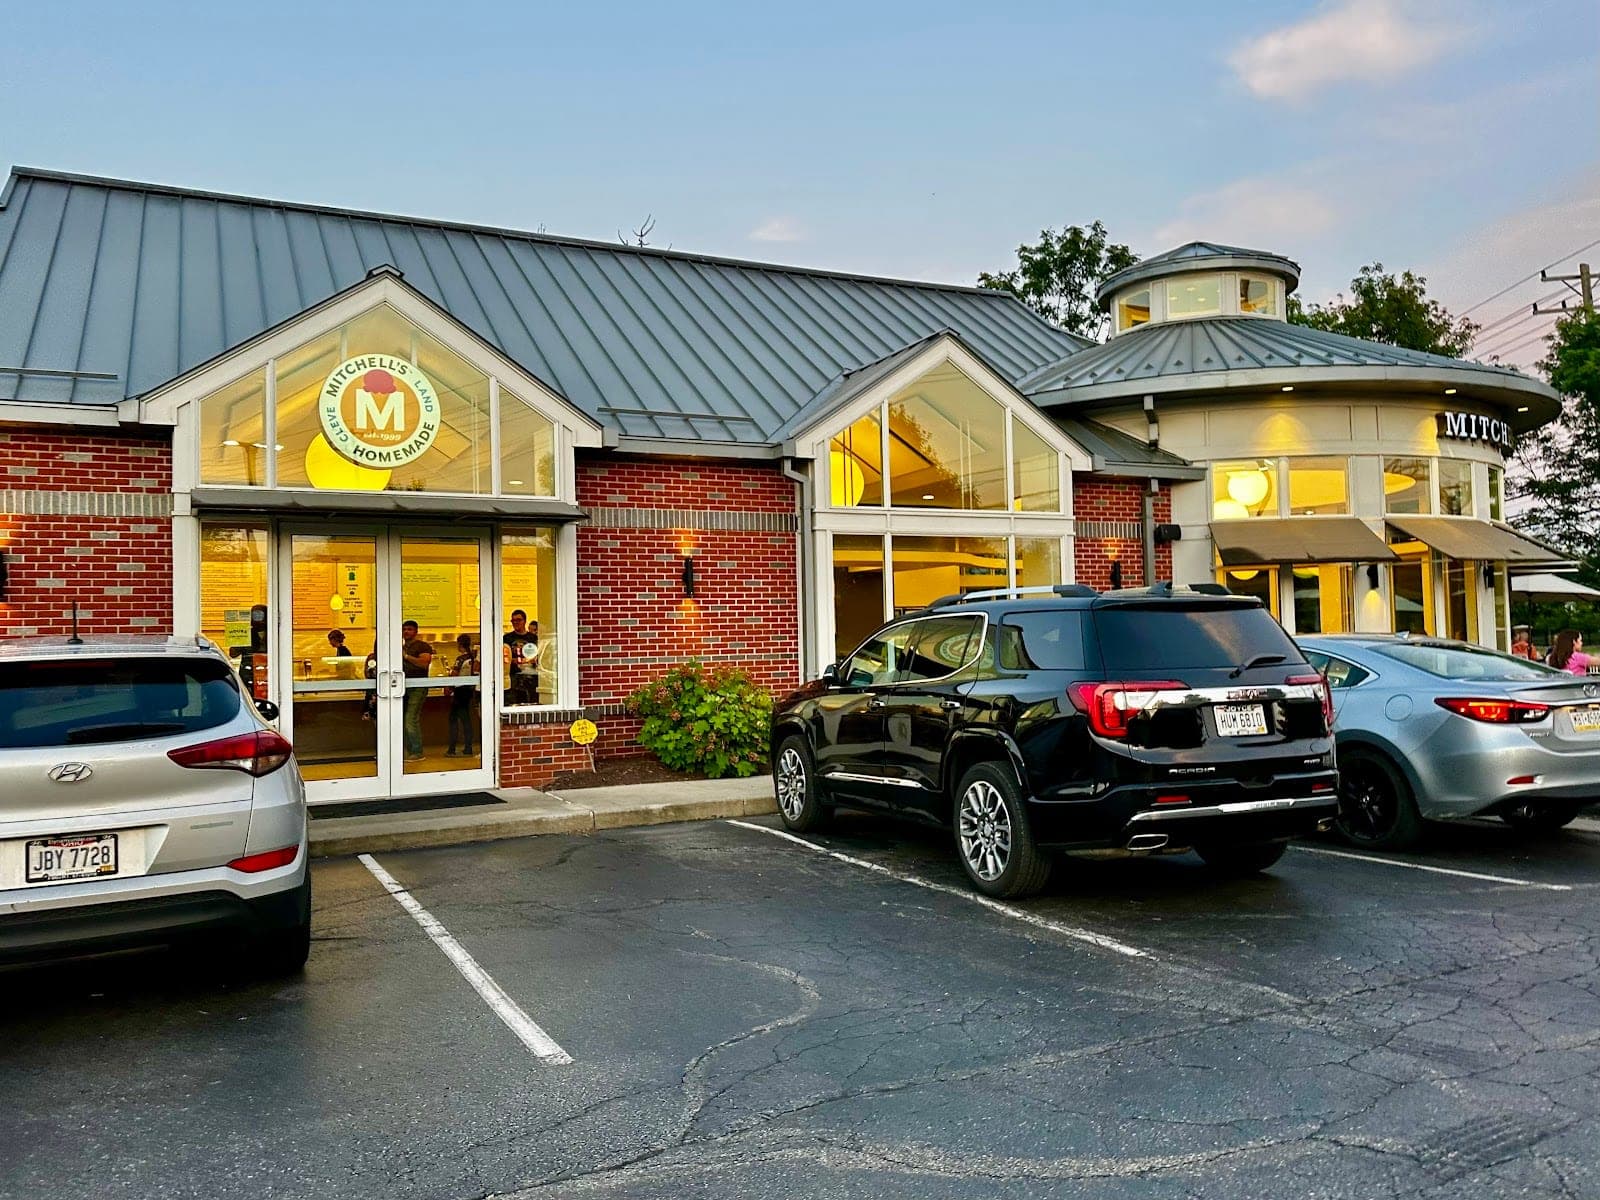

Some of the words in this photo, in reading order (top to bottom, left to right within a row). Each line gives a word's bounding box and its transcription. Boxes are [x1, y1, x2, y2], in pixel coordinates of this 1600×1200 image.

[325, 357, 409, 398] MITCHELL'S
[355, 388, 405, 432] M
[414, 380, 433, 413] LAND
[326, 406, 349, 442] CLEVE
[352, 421, 435, 463] HOMEMADE
[1168, 766, 1216, 774] ACADIA
[33, 849, 64, 871] JBY
[70, 845, 110, 868] 7728
